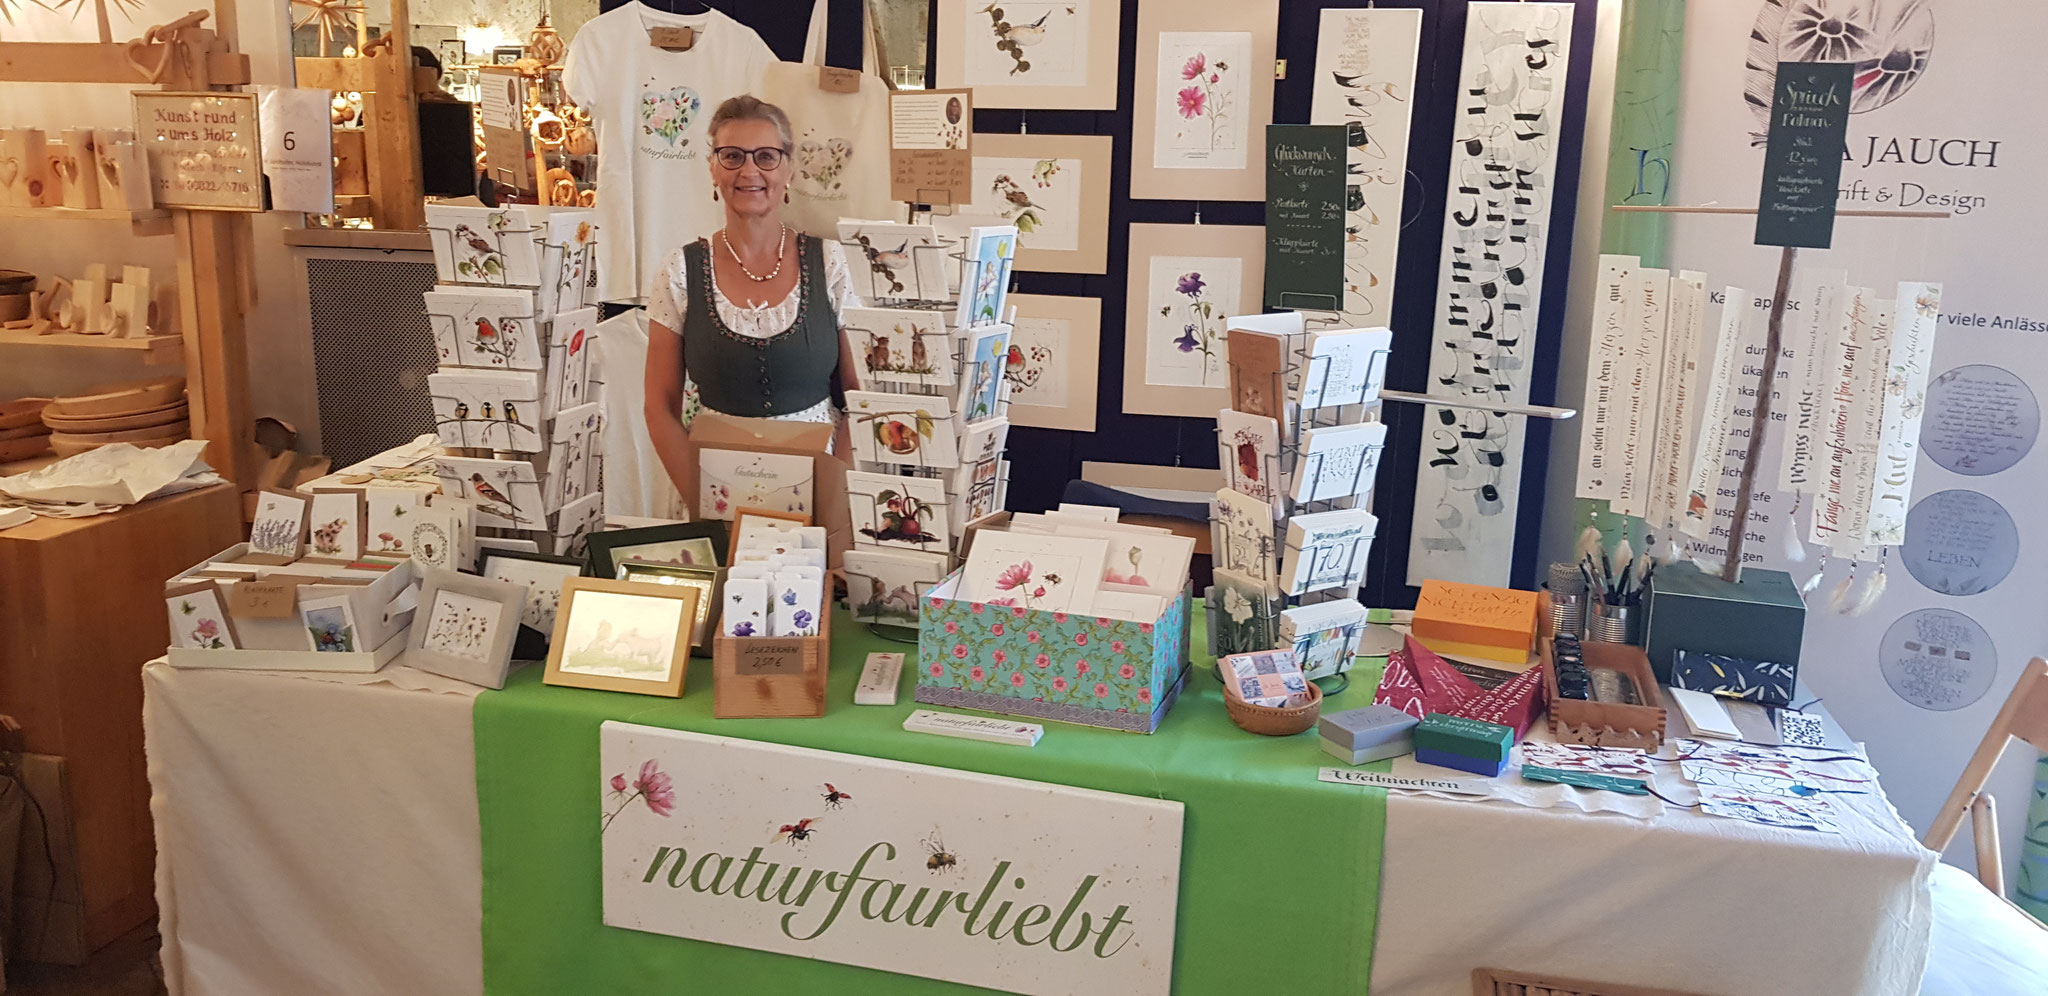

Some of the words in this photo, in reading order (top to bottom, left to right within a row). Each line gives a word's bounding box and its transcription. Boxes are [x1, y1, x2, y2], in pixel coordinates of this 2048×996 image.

[154, 108, 198, 124] Kunst
[204, 110, 237, 124] rund
[203, 127, 236, 142] Holz
[283, 131, 296, 151] 6
[1863, 136, 2002, 168] JAUCH
[1876, 187, 1893, 202] &
[1898, 182, 1986, 215] Design
[1609, 284, 1622, 302] gut
[1643, 289, 1658, 309] gut
[1948, 313, 1986, 327] viele
[1991, 316, 2048, 332] Anläss
[1841, 342, 1862, 361] auf
[1595, 360, 1611, 381] dem
[1631, 368, 1642, 390] dem
[1838, 363, 1854, 377] nie
[1595, 385, 1609, 402] mit
[1833, 381, 1853, 403] Höre
[1630, 396, 1640, 412] mit
[1595, 405, 1607, 423] nur
[1628, 416, 1637, 436] nur
[1623, 443, 1635, 469] sieht
[1831, 465, 1842, 476] an
[1830, 480, 1841, 494] nie
[1815, 497, 1840, 538] Fange
[1692, 542, 1763, 562] Widmgen
[934, 716, 1011, 732] naturfairliebt
[642, 842, 1135, 958] naturfairliebt
